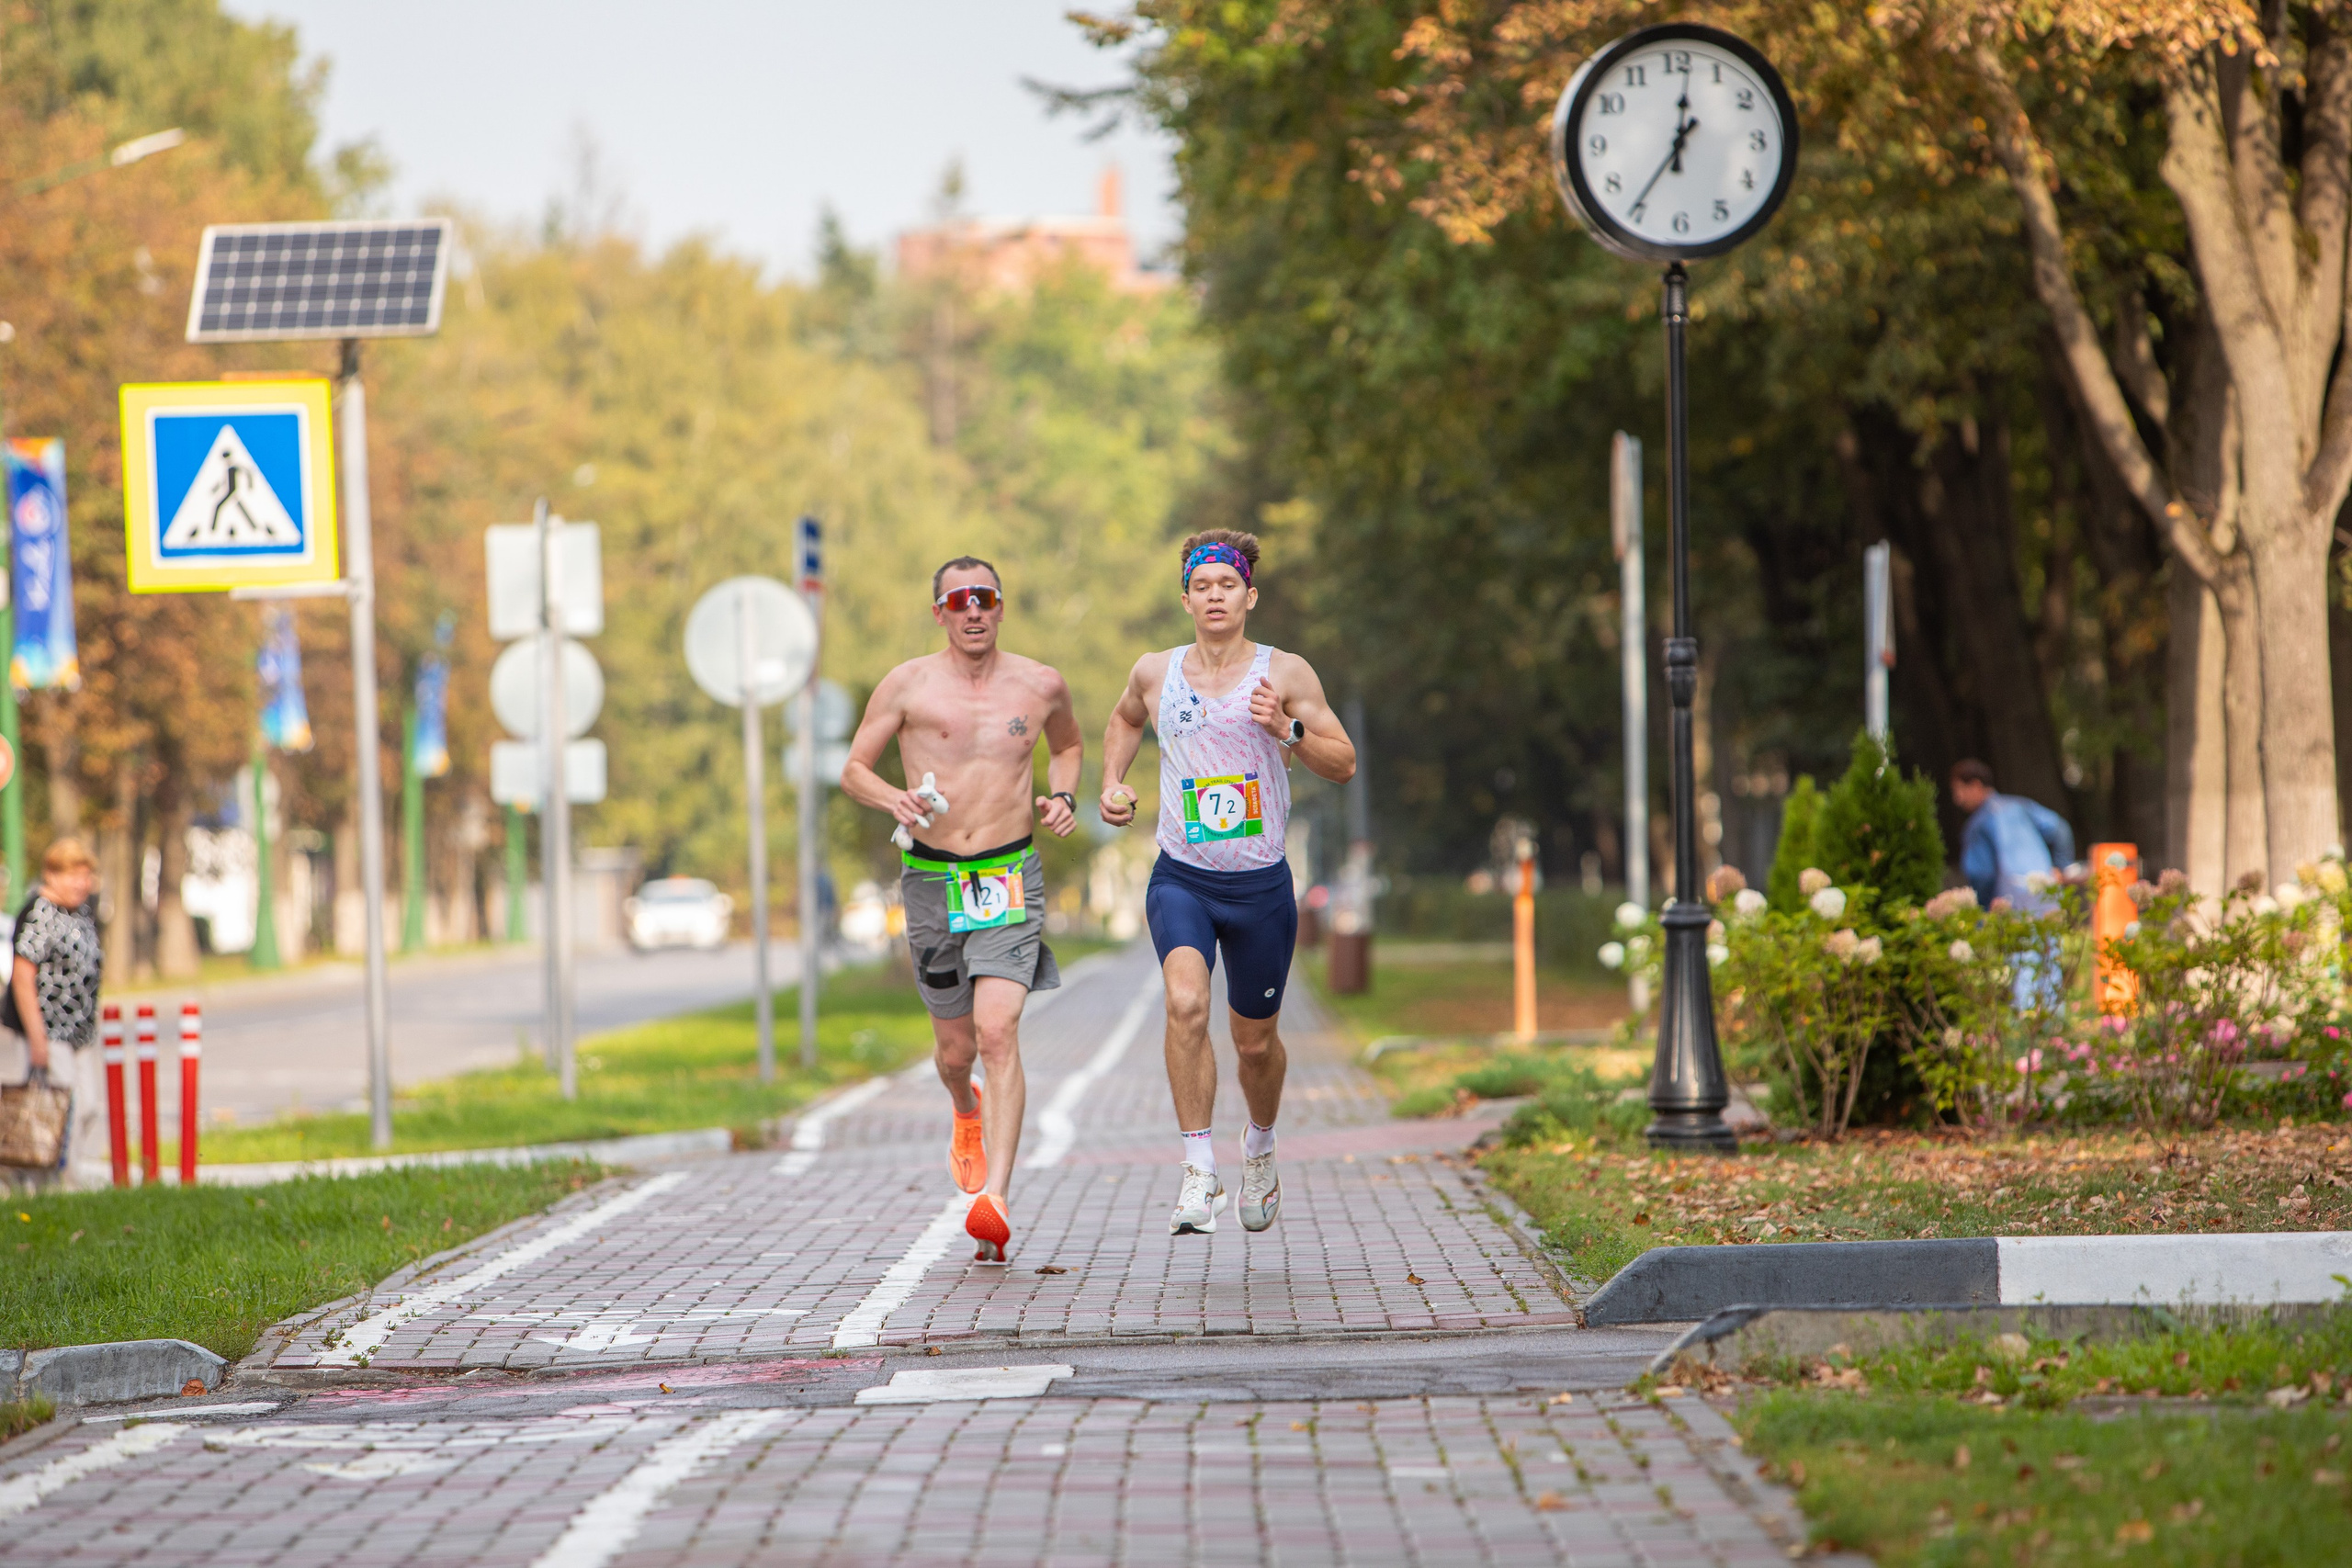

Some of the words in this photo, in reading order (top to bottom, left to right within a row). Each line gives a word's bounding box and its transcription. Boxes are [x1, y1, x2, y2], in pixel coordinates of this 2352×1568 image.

[1662, 51, 1691, 73] 12
[1625, 65, 1646, 86] 11
[1712, 63, 1723, 84] 1
[1599, 92, 1625, 114] 10
[1736, 88, 1755, 110] 2
[1589, 134, 1607, 156] 9
[1749, 129, 1767, 152] 3
[1604, 172, 1622, 194] 8
[1740, 168, 1754, 190] 4
[1713, 199, 1729, 221] 5
[1671, 210, 1689, 233] 6
[1209, 793, 1221, 815] 7
[1227, 799, 1236, 814] 2
[996, 892, 1001, 904] 1
